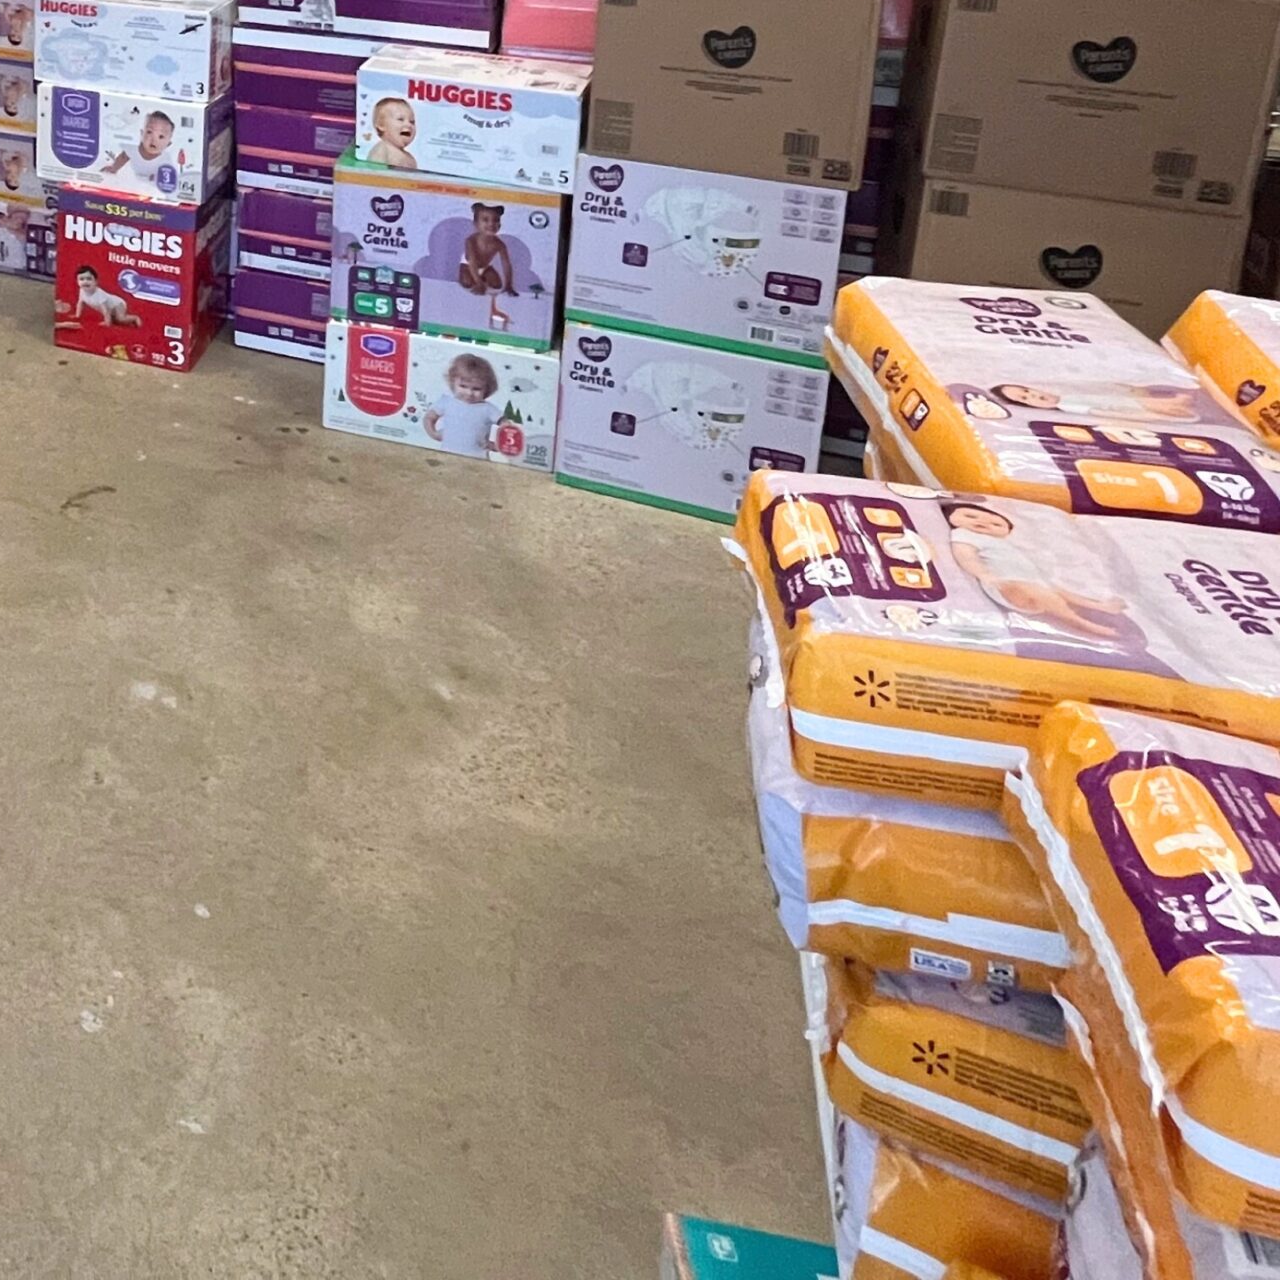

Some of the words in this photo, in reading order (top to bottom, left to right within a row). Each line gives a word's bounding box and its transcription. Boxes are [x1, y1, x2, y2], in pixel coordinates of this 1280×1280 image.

[40, 0, 98, 18] HUGGIES
[196, 82, 205, 95] 3
[408, 79, 513, 112] HUGGIES
[162, 170, 171, 183] 3
[558, 170, 569, 185] 5
[584, 191, 610, 207] Dry
[614, 196, 625, 207] &
[105, 203, 128, 217] $35
[580, 202, 628, 219] Gentle
[65, 214, 183, 259] HUGGIES
[367, 222, 392, 237] Dry
[395, 227, 406, 237] &
[363, 234, 409, 249] Gentle
[108, 252, 135, 266] little
[137, 260, 181, 274] movers
[375, 298, 389, 315] 5
[973, 315, 1038, 329] Dry
[974, 324, 1092, 344] Gentle
[167, 340, 185, 365] 3
[573, 360, 599, 376] Dry
[602, 366, 612, 377] &
[569, 370, 615, 389] Gentle
[526, 443, 548, 458] 128
[1141, 470, 1180, 504] 1
[1164, 572, 1212, 615] Diapers
[1182, 558, 1273, 635] Gentle
[1226, 570, 1280, 610] Dry
